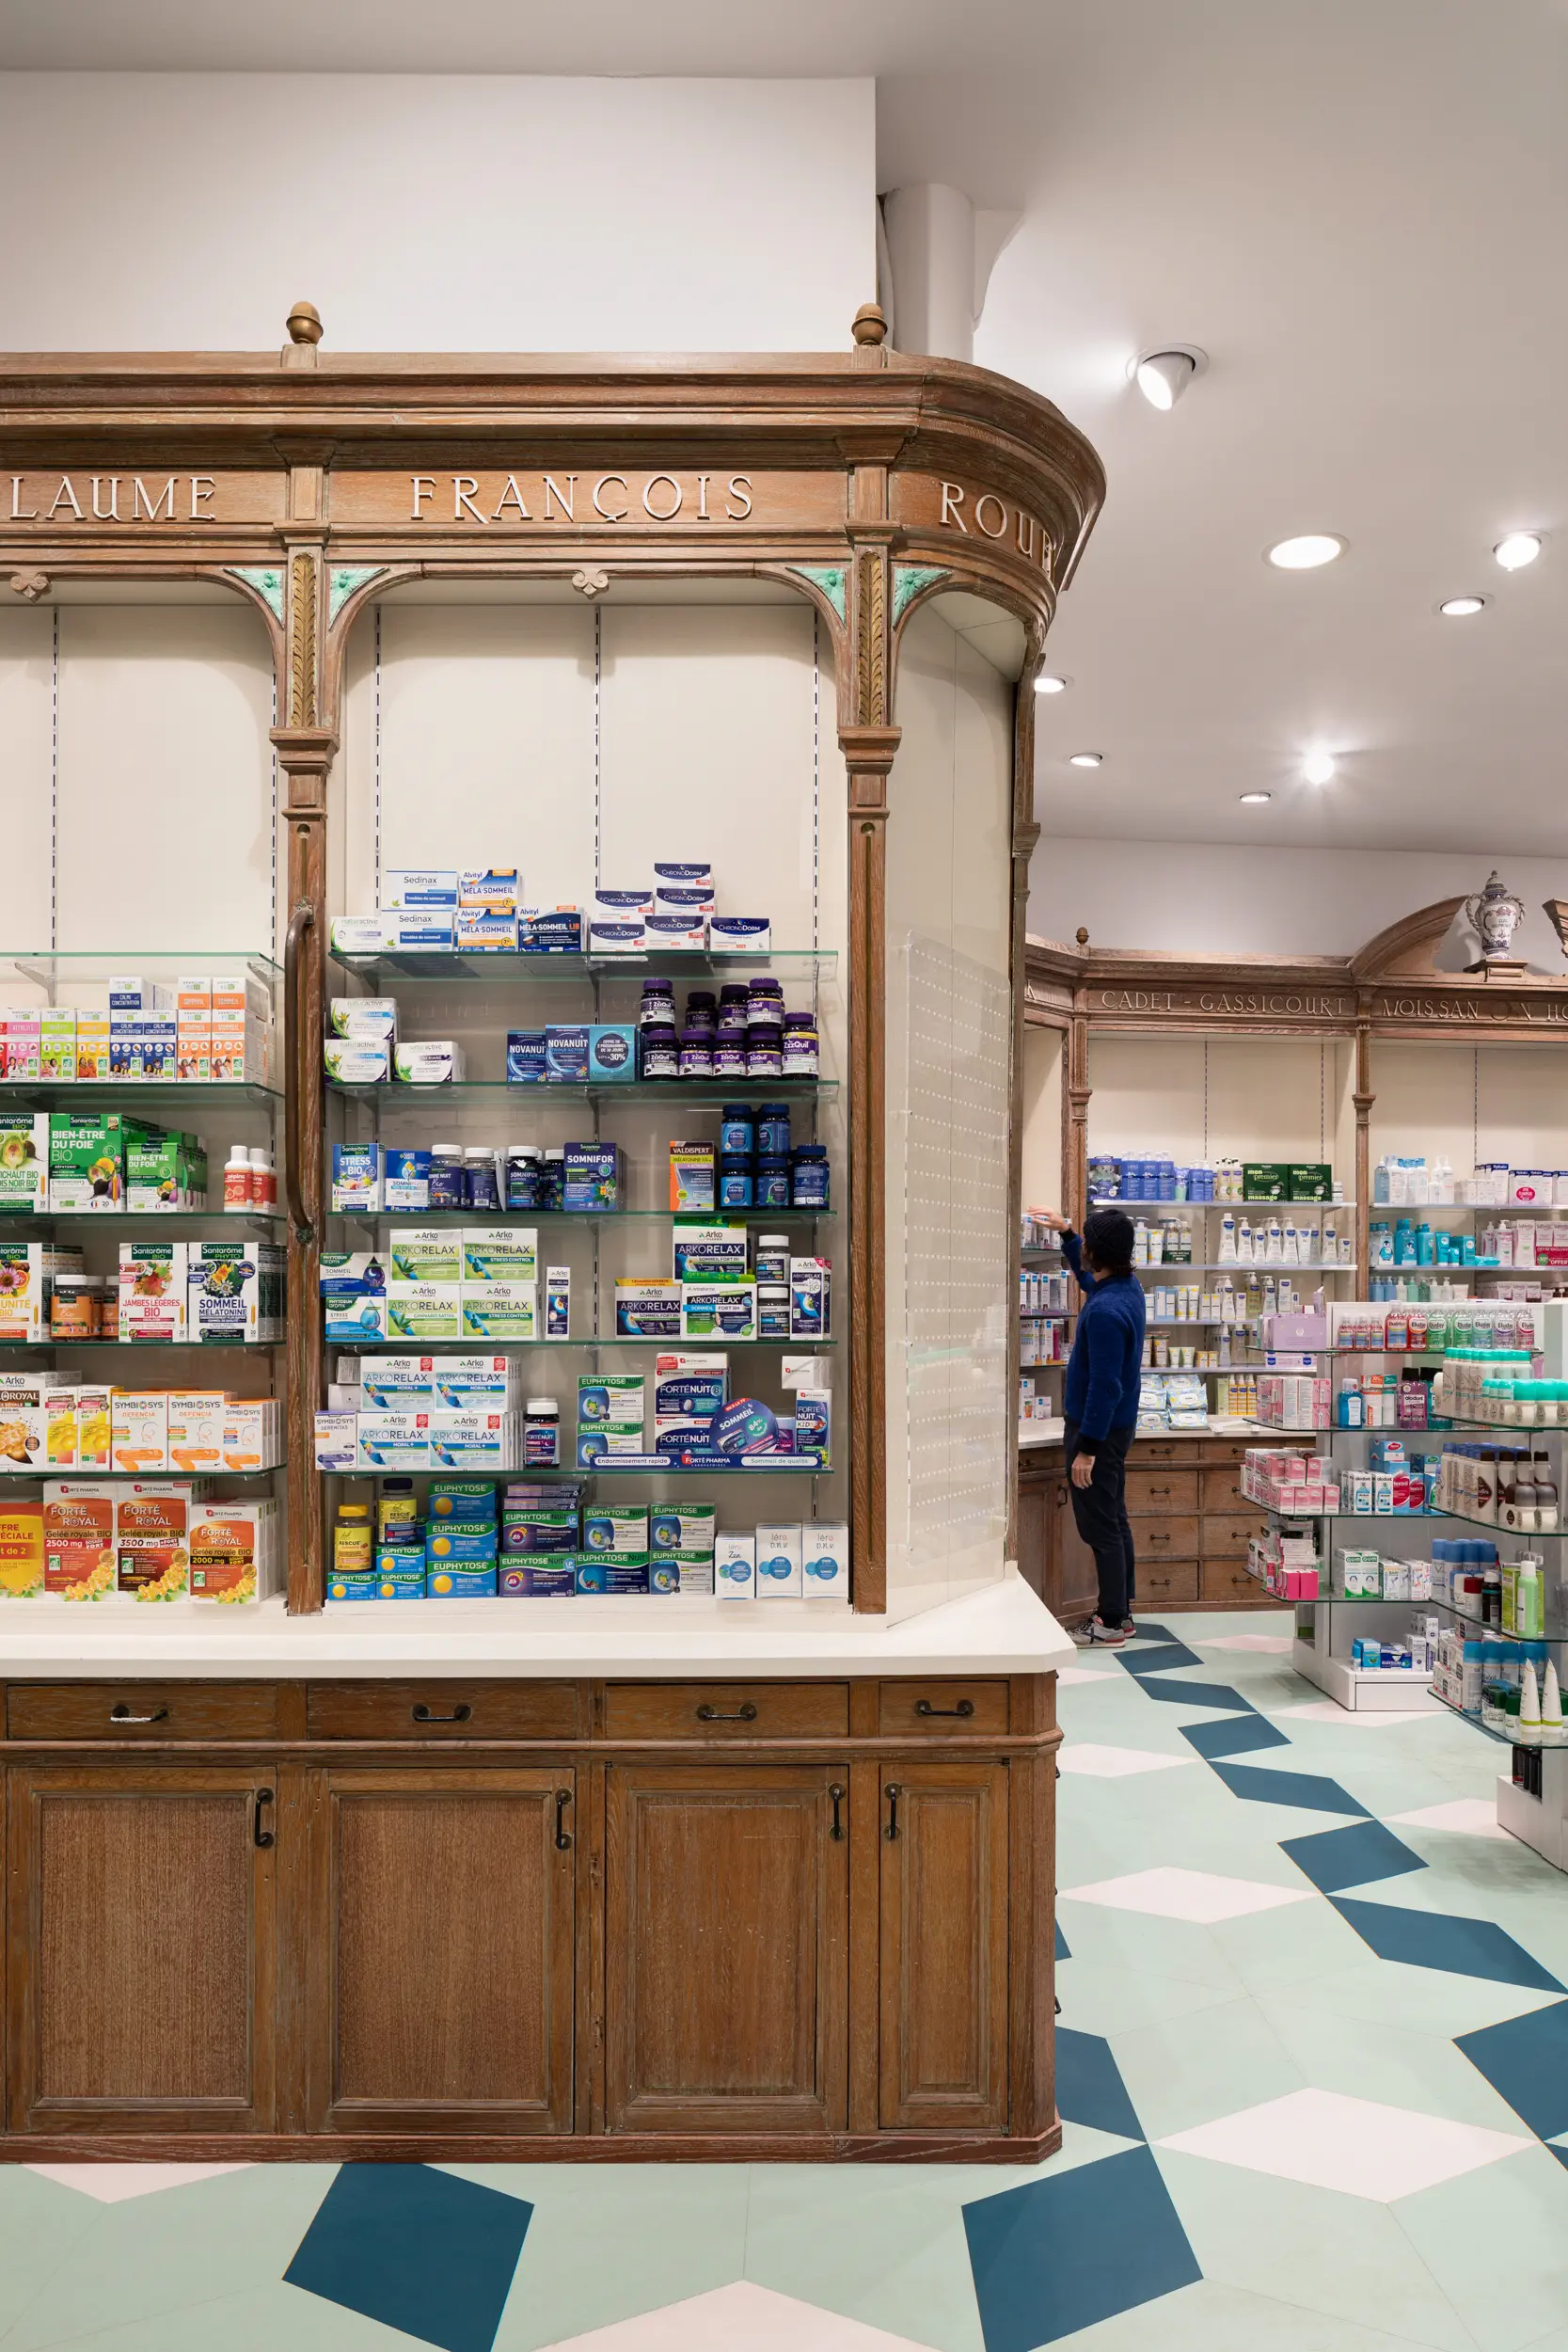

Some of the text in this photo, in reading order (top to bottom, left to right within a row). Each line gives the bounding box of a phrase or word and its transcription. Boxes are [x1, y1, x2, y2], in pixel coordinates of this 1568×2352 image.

[9, 475, 216, 521] LAUME
[410, 474, 752, 523] FRANÇOIS
[404, 876, 437, 884] Sedinax
[399, 914, 432, 923] Sedinax
[1101, 991, 1346, 1017] CADET GASSICOURT
[52, 1129, 105, 1139] BIEN-ÊTRE
[52, 1140, 94, 1149] DU FOIE
[52, 1150, 72, 1161] BIO
[341, 1157, 371, 1166] STRESS
[133, 1246, 171, 1254] Santarôme
[202, 1246, 243, 1254] Santarôme
[394, 1246, 455, 1255] ARKORELAX
[467, 1246, 531, 1254] ARKORELAX
[678, 1246, 741, 1254] ARKORELAX
[190, 1263, 195, 1272] 3
[199, 1299, 246, 1308] SOMMEIL
[391, 1302, 453, 1311] ARKORELAX
[465, 1301, 528, 1311] ARKORELAX
[621, 1302, 679, 1311] ARKORELAX
[144, 1308, 160, 1317] BIO
[365, 1374, 428, 1383] ARKORELAX
[439, 1374, 501, 1383] ARKORELAX
[660, 1384, 711, 1393] FORTÉNUIT
[115, 1401, 164, 1409] SYMBIOSYS
[171, 1401, 220, 1409] SYMBIOSYS
[720, 1408, 754, 1431] SOMMEIL
[433, 1431, 496, 1440] ARKORELAX
[51, 1505, 87, 1515] FORTÉ
[124, 1505, 160, 1515] FORTÉ
[63, 1518, 99, 1527] ROYAL
[135, 1517, 171, 1526] ROYAL
[433, 1524, 486, 1533] EUPHYTOSE
[71, 1531, 94, 1539] royale
[143, 1530, 167, 1538] royale
[434, 1562, 487, 1570] EUPHYTOSE
